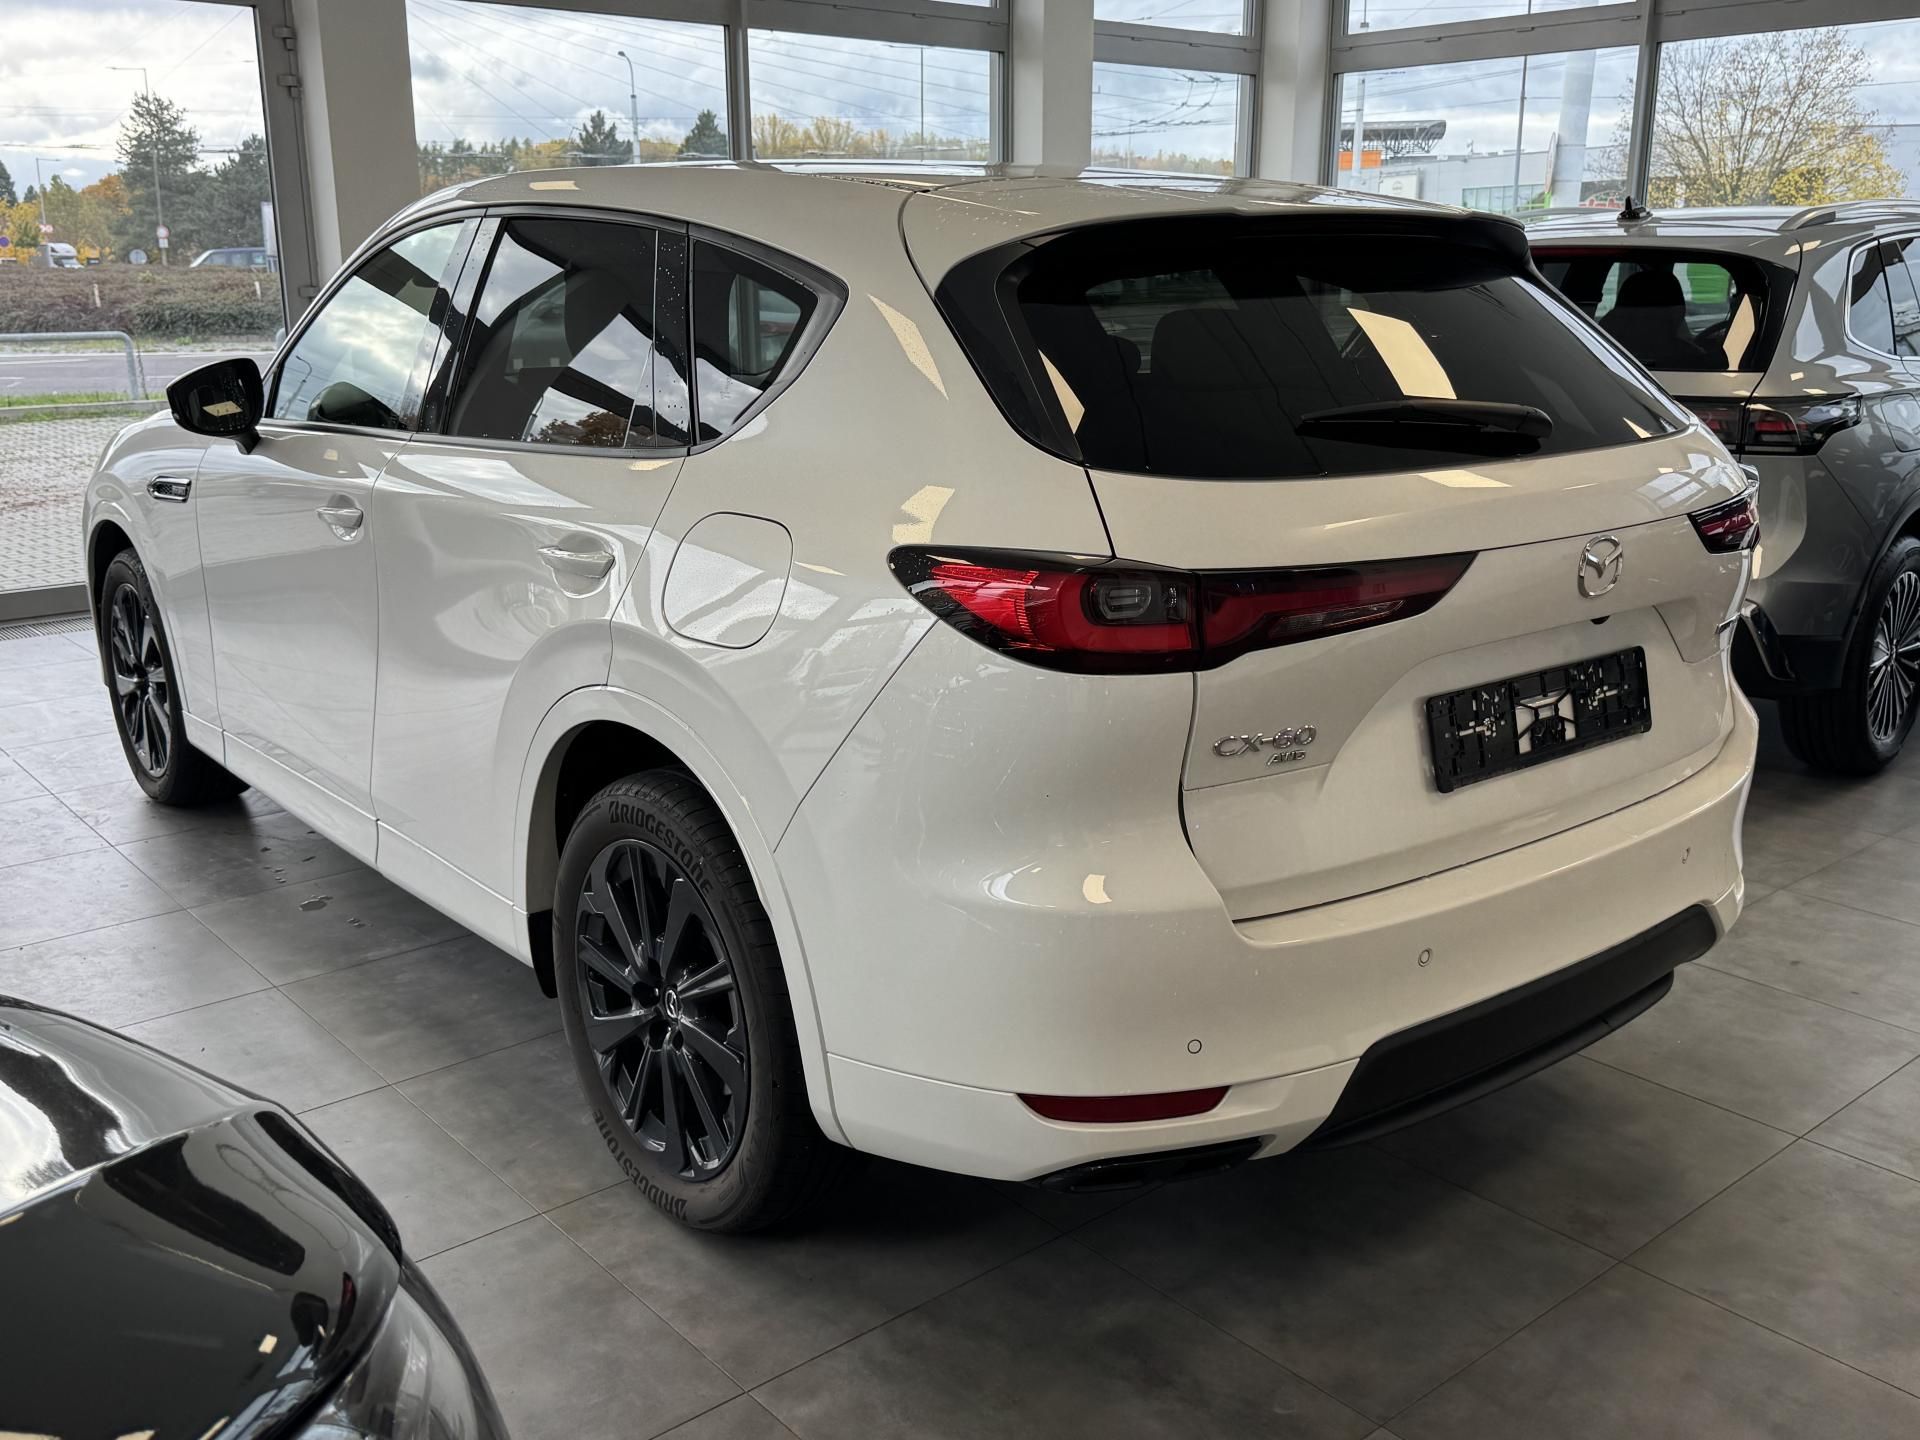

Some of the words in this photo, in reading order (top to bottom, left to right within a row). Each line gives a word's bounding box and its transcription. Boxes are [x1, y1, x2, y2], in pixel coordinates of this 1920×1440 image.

[1213, 724, 1317, 757] CX-60
[1265, 749, 1307, 767] AWD
[608, 800, 715, 898] BRIDGESTONE
[592, 1109, 690, 1222] BRIDGESTONE
